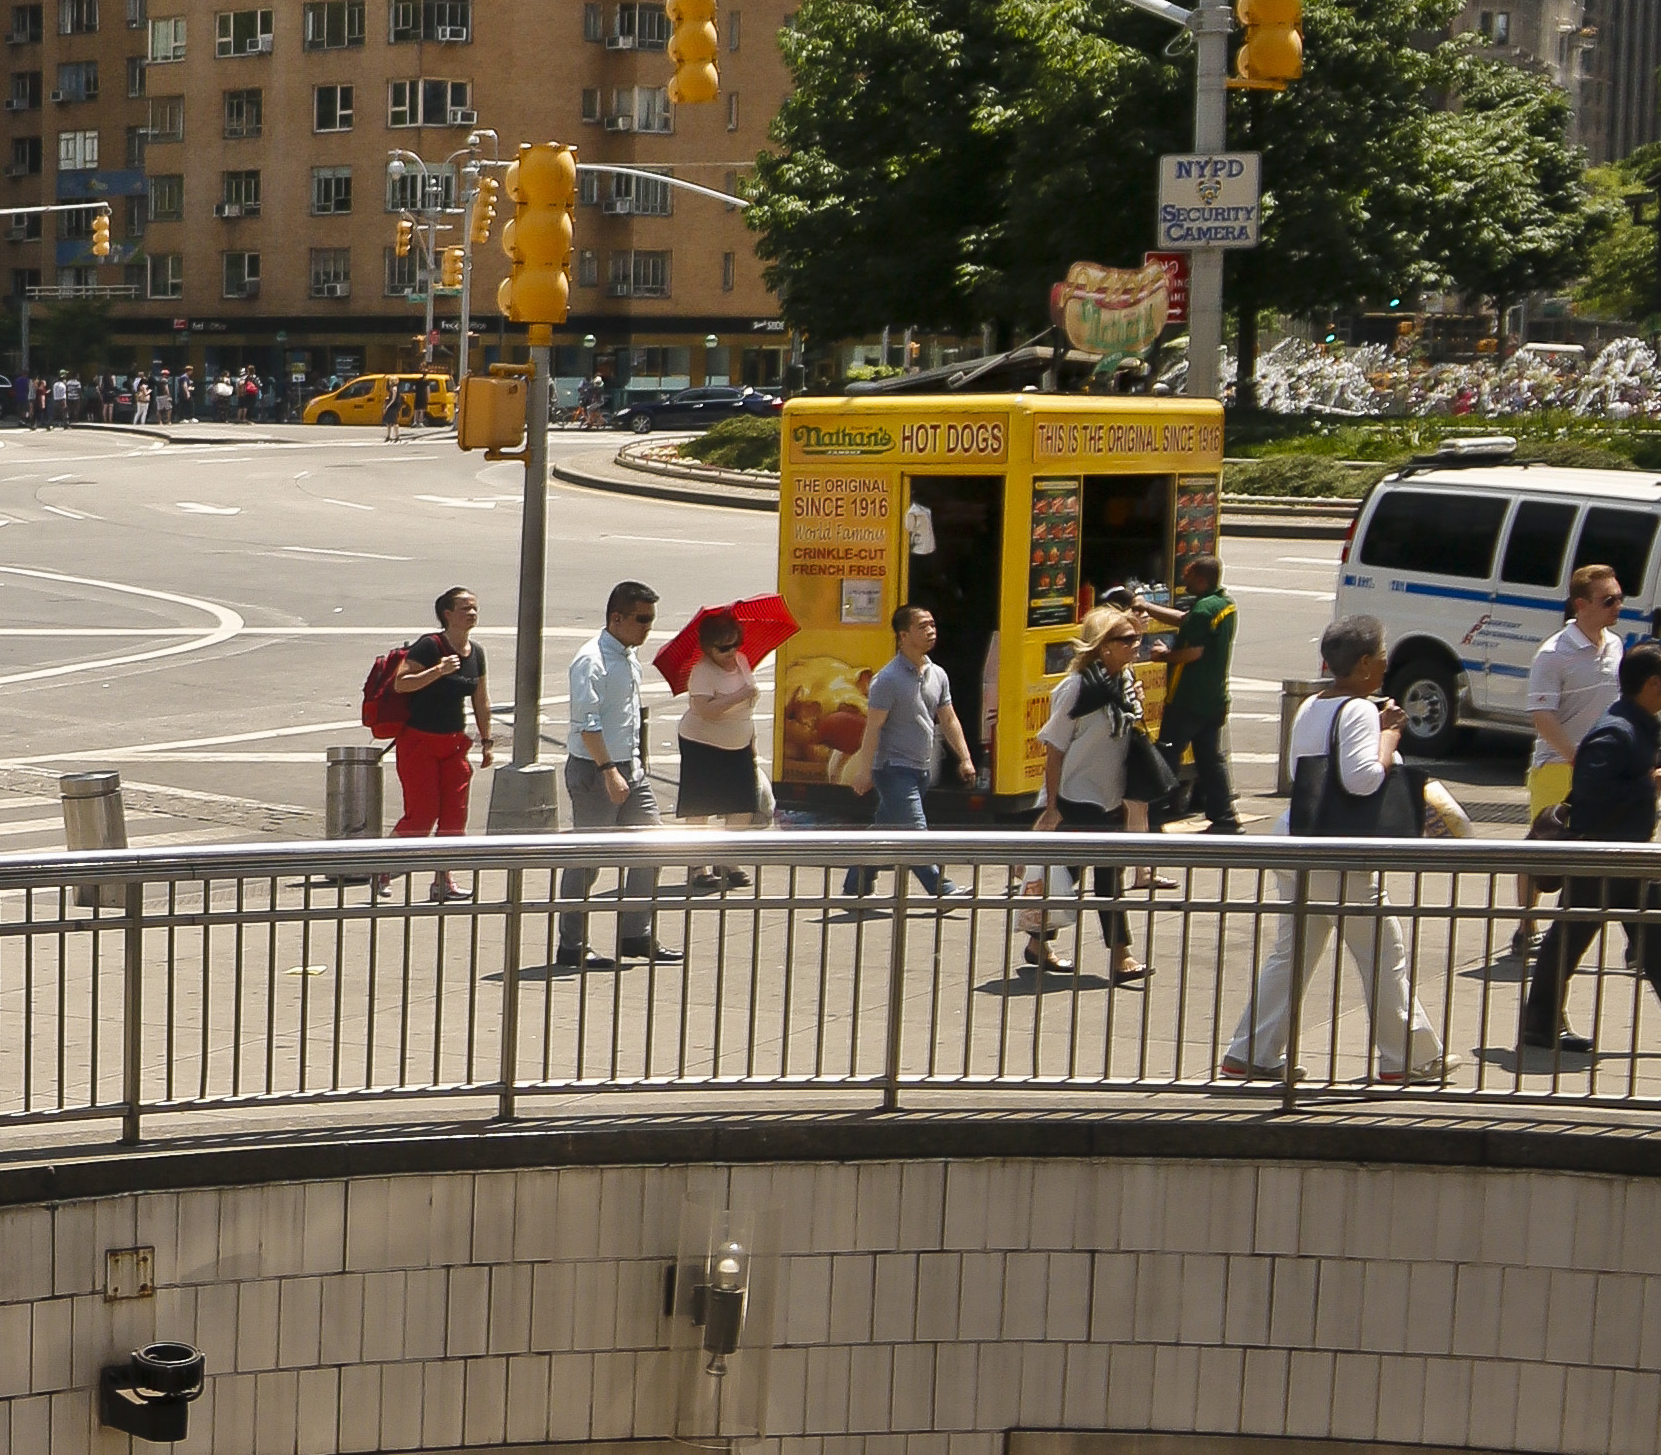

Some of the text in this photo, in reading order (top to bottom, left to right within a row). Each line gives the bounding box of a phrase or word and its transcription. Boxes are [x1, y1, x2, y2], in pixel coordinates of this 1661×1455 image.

[1175, 158, 1245, 179] NYPD
[1162, 203, 1256, 223] SECURITY
[1166, 222, 1251, 242] CAMERA
[793, 423, 1004, 455] Nathan's HOT DOGS
[1038, 424, 1221, 454] THIS IS THE ORIGINAL SINCE 1916
[795, 478, 889, 493] THE ORIGINAL
[794, 496, 888, 517] SINCE 1916
[795, 522, 832, 541] World
[793, 547, 886, 561] CRINKLE-CUT
[792, 563, 887, 577] FRENCH FRIES
